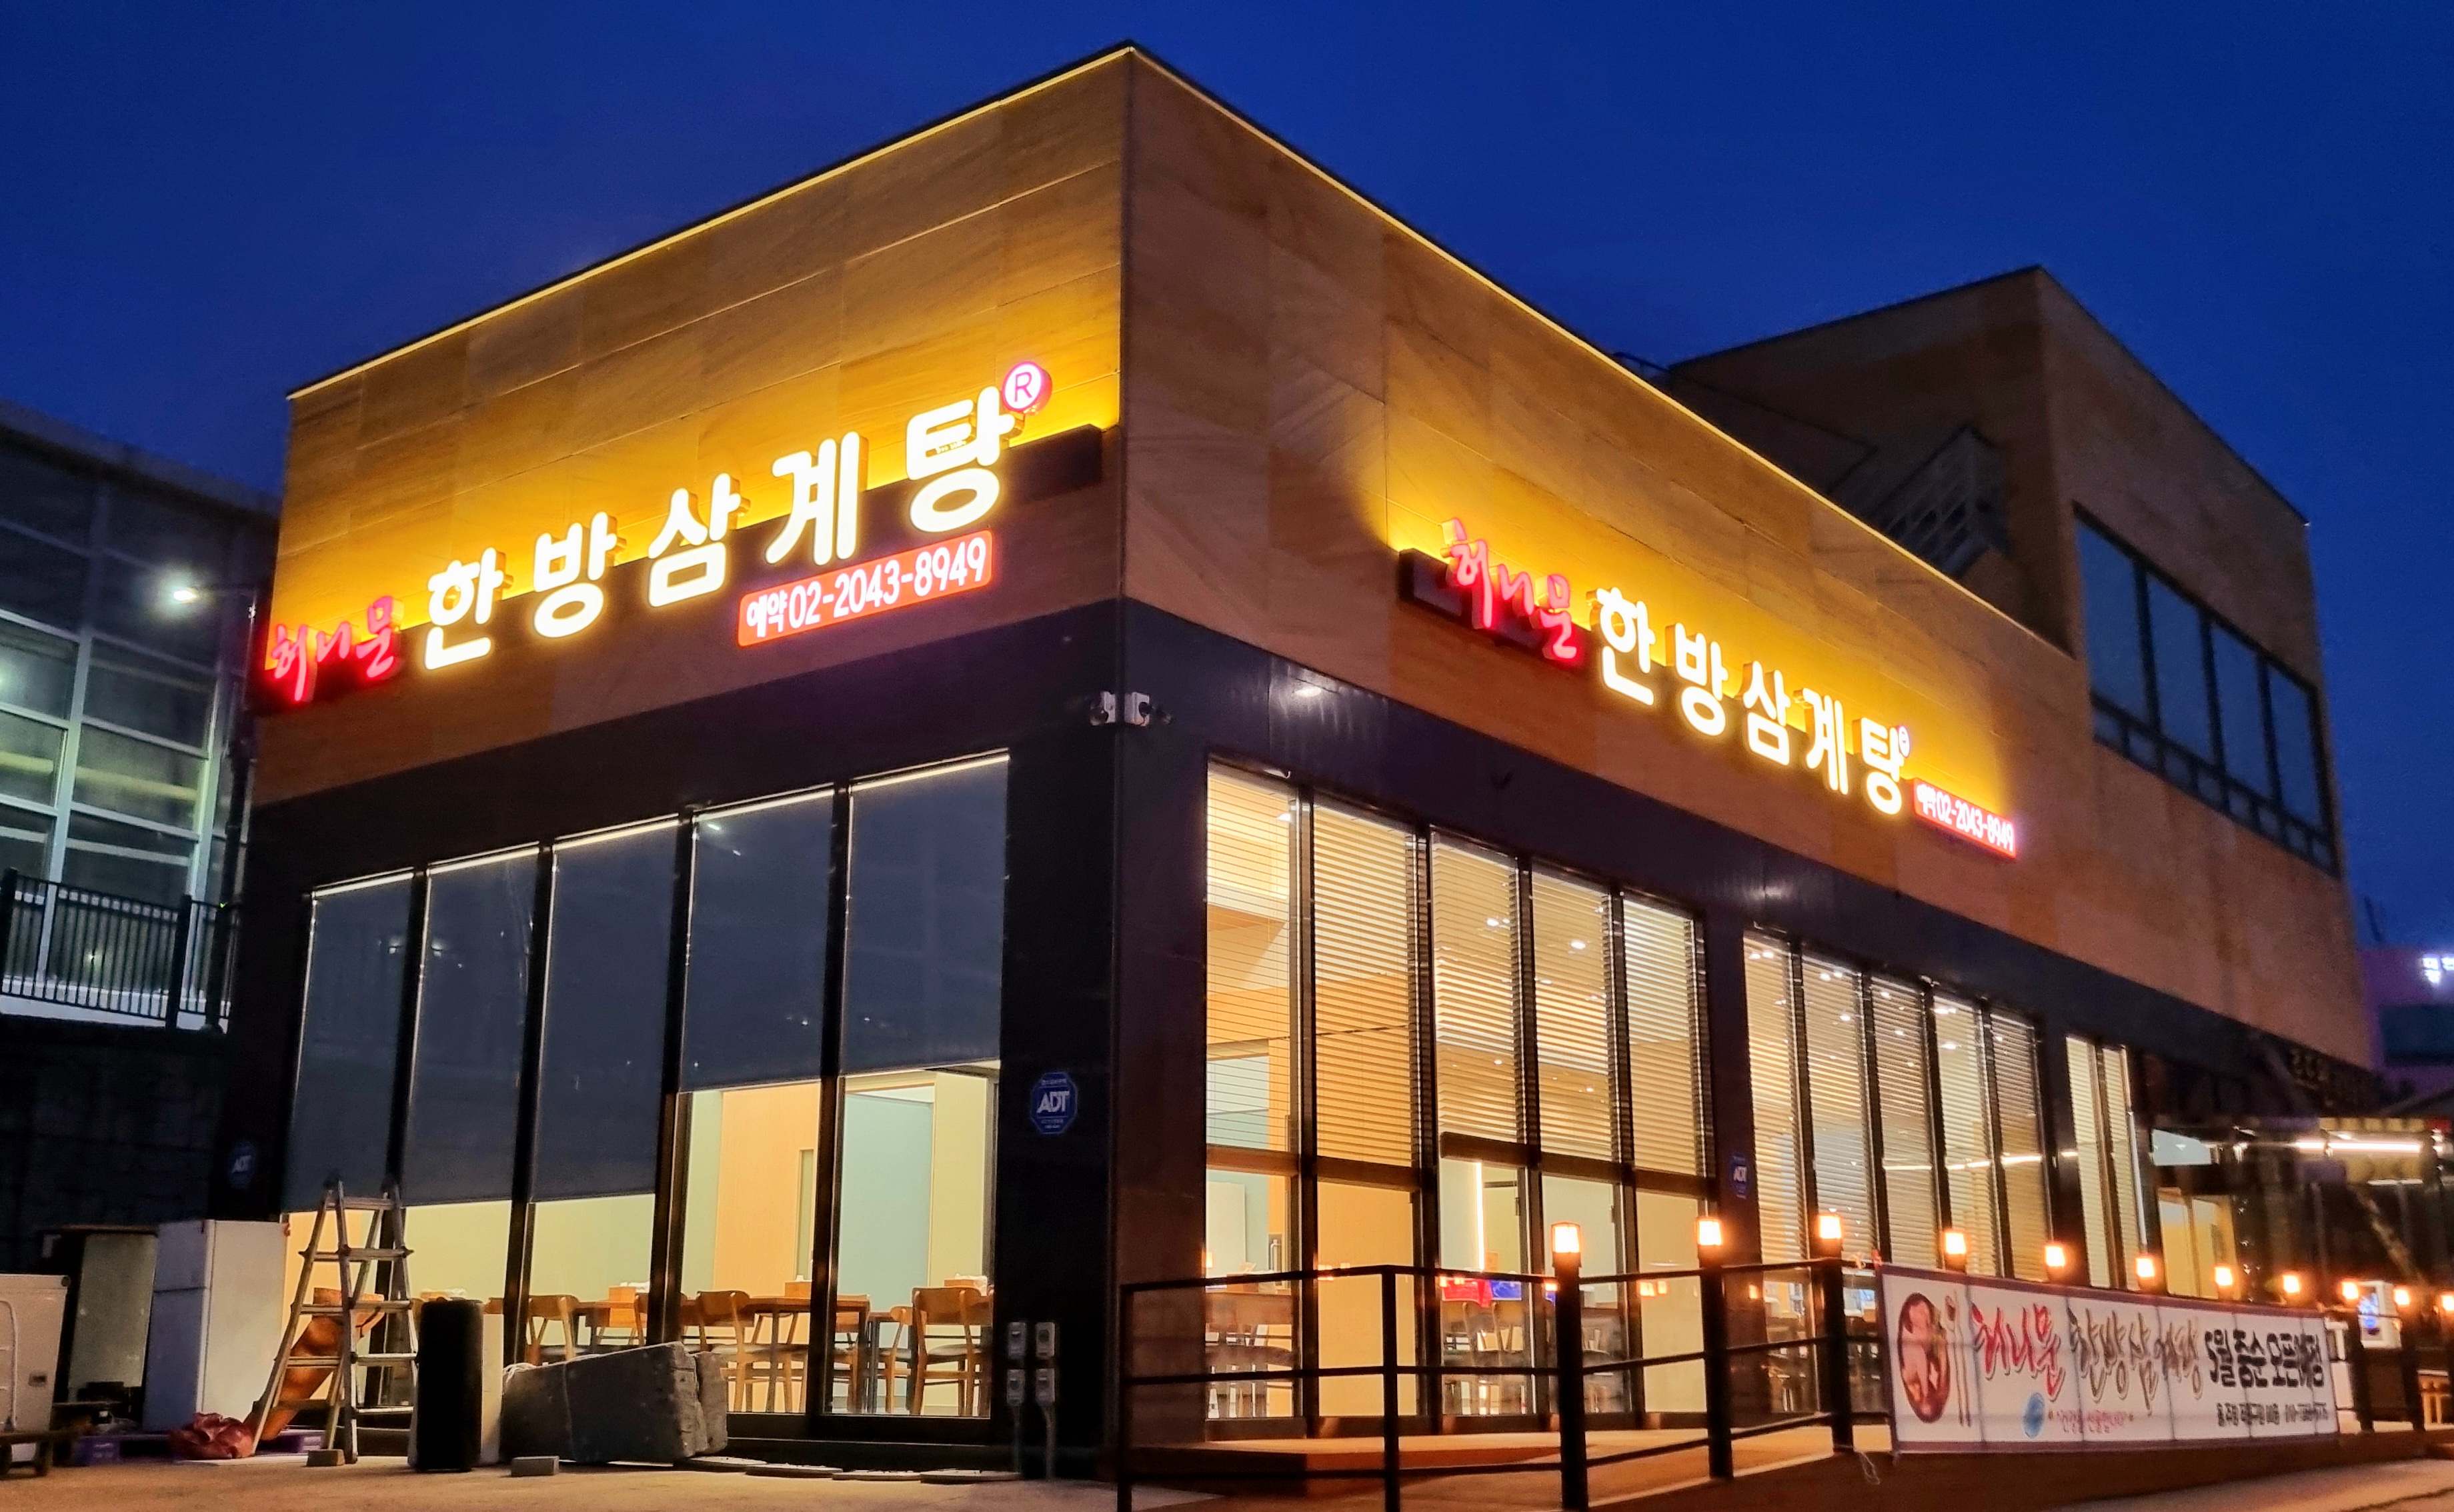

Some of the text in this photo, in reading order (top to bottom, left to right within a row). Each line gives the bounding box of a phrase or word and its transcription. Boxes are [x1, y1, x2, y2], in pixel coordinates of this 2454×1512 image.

[425, 386, 1014, 669] 한방삼계탕
[746, 537, 986, 637] 예약 02-2043-8949
[1596, 587, 1905, 815] 한방삼계탕
[1937, 791, 2015, 852] 02-2043-8949
[1036, 1091, 1070, 1113] ADT
